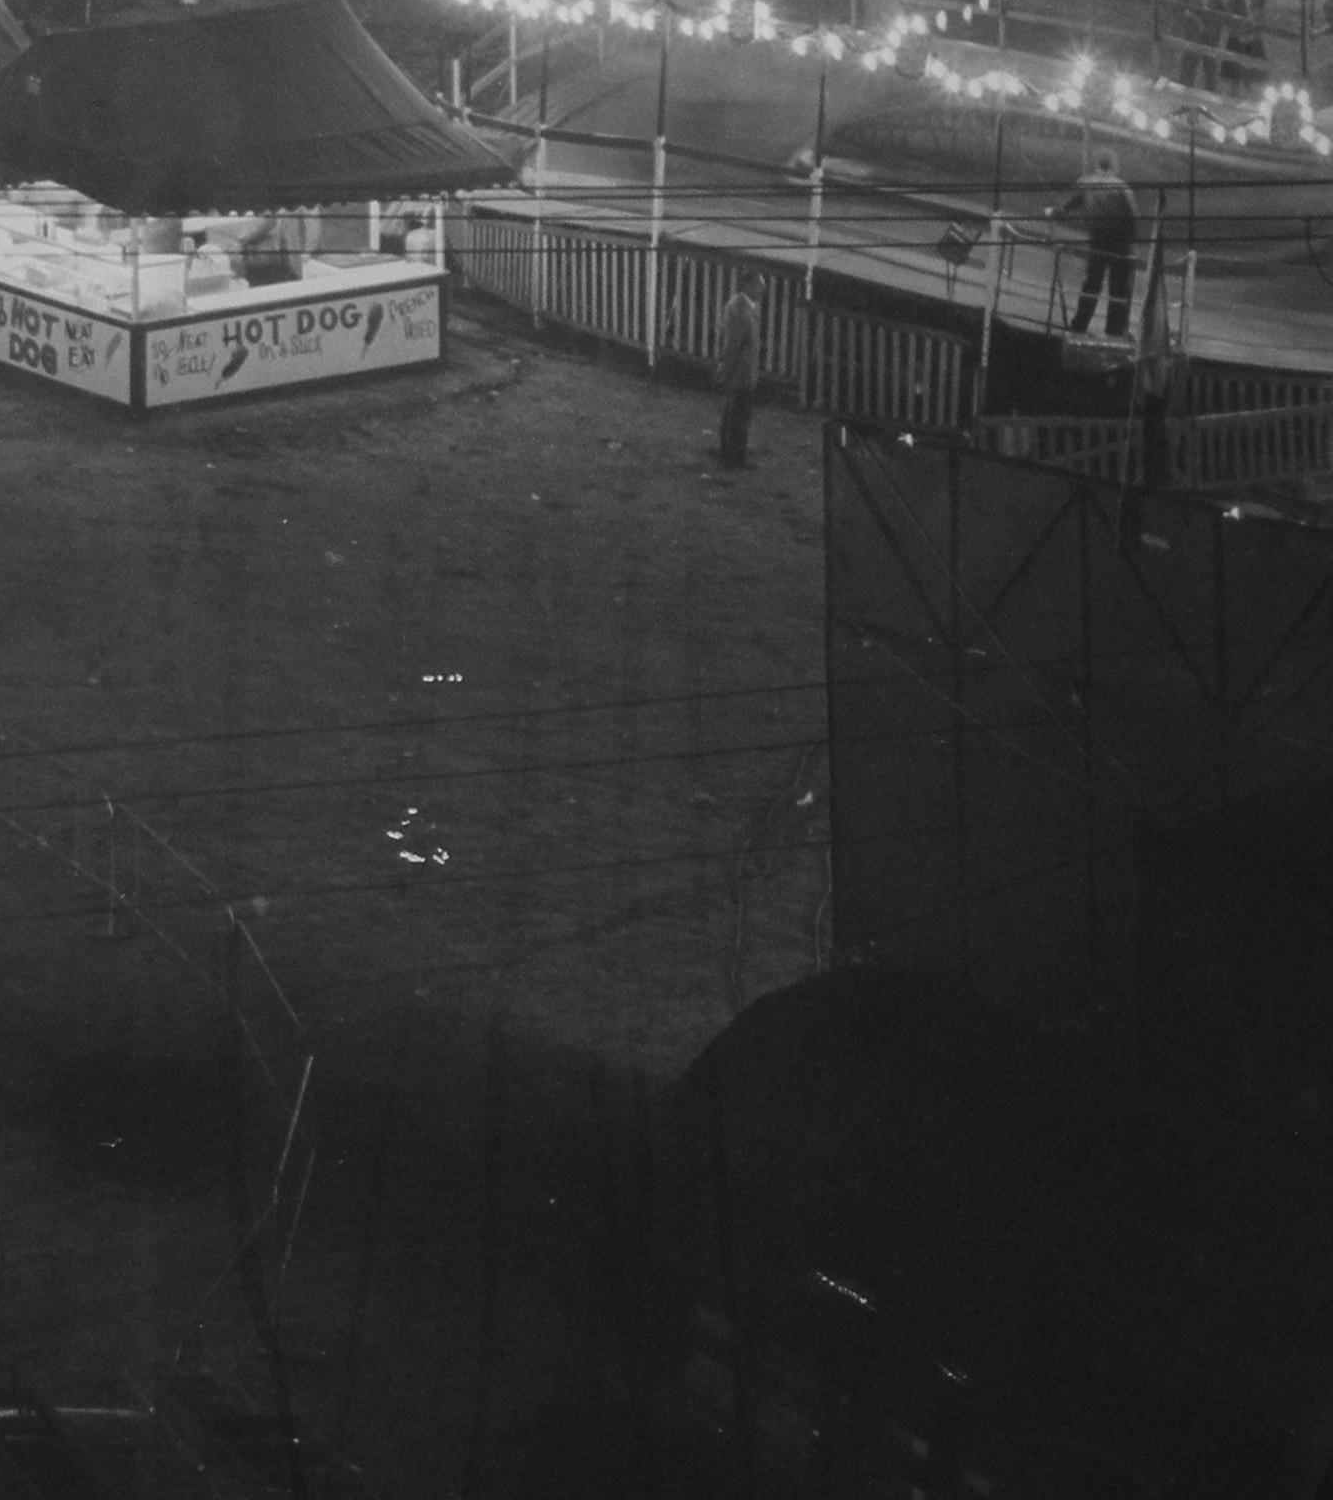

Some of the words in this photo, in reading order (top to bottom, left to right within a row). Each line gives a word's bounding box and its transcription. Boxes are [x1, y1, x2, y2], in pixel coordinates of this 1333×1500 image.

[11, 296, 61, 340] HOT
[223, 314, 286, 348] HOT
[296, 304, 363, 336] DOG
[9, 331, 58, 376] DOG
